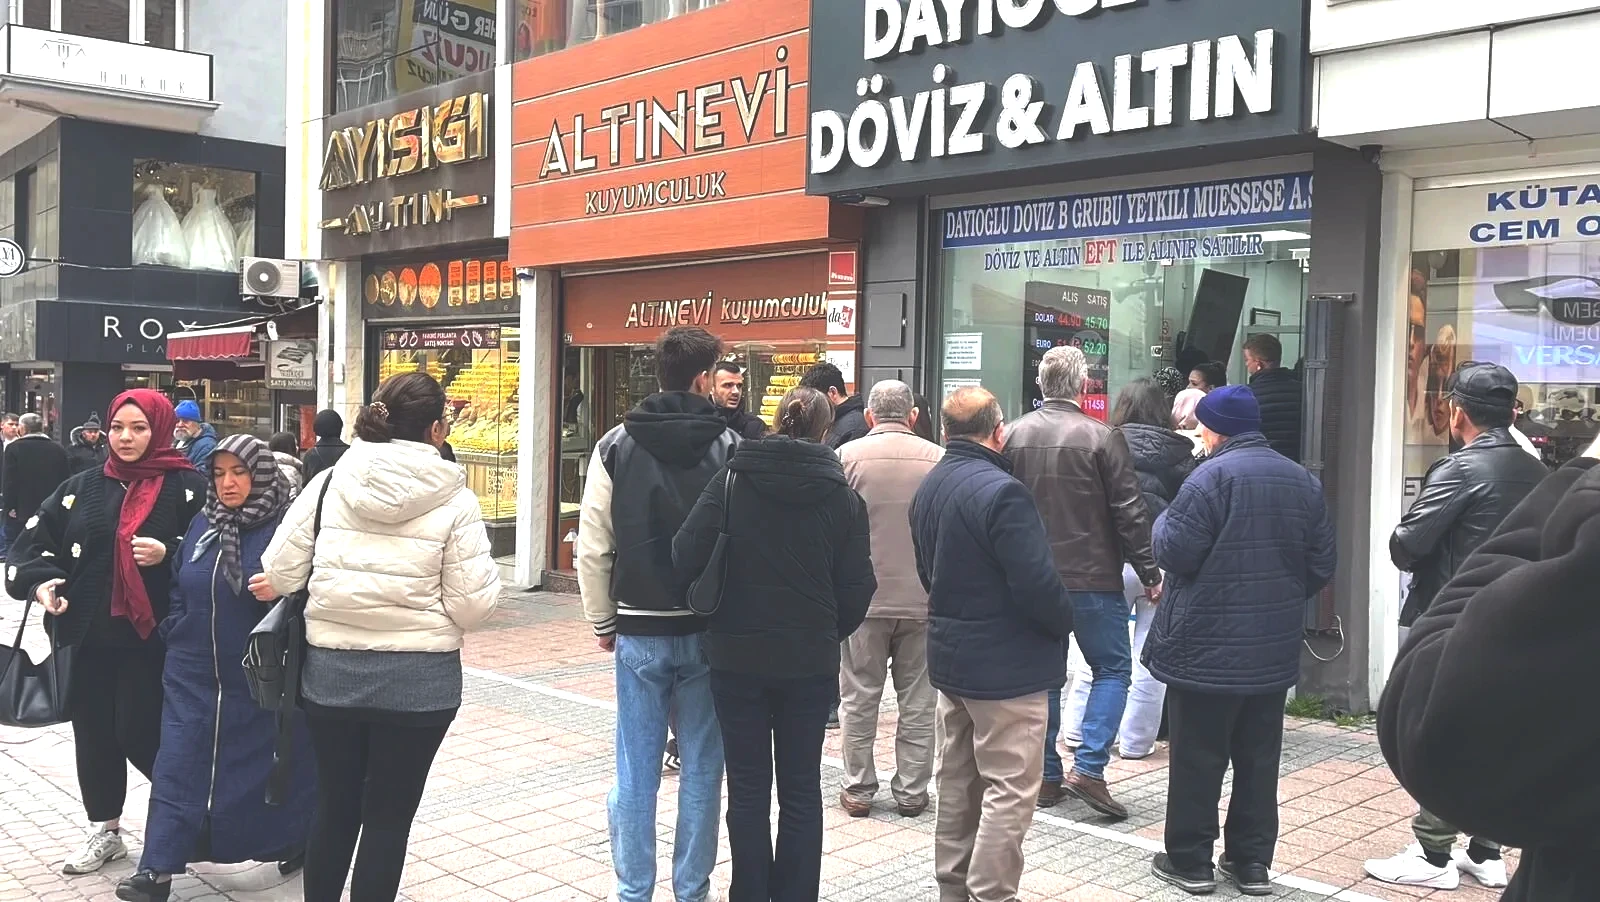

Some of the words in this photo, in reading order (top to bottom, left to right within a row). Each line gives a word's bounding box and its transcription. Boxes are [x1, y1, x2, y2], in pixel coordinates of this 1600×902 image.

[539, 45, 789, 178] ALTINEVİ
[811, 63, 987, 174] DÖVİZ
[996, 73, 1047, 148] &
[1056, 28, 1274, 140] ALTIN
[585, 170, 727, 215] KUYUMCULUK
[1058, 200, 1068, 230] B
[1072, 194, 1123, 229] GRUBU
[1469, 218, 1560, 243] CEM
[984, 247, 1021, 271] DÖVİZ
[1024, 249, 1040, 268] VE
[1043, 246, 1081, 267] ALTIN
[1084, 239, 1118, 264] EFT
[1122, 239, 1145, 262] İLE
[1148, 238, 1198, 261] ALINIR
[1202, 233, 1264, 257] SATILIR
[624, 290, 714, 328] ALTINEVİ
[720, 291, 828, 326] kuyumculuk
[1062, 291, 1079, 304] ALIŞ
[1087, 294, 1108, 308] SATIŞ
[1035, 313, 1054, 323] DOLAR
[1084, 317, 1108, 330] 45.70
[1036, 339, 1051, 349] EURO
[1084, 341, 1107, 355] 52.20
[1084, 399, 1105, 410] 11458
